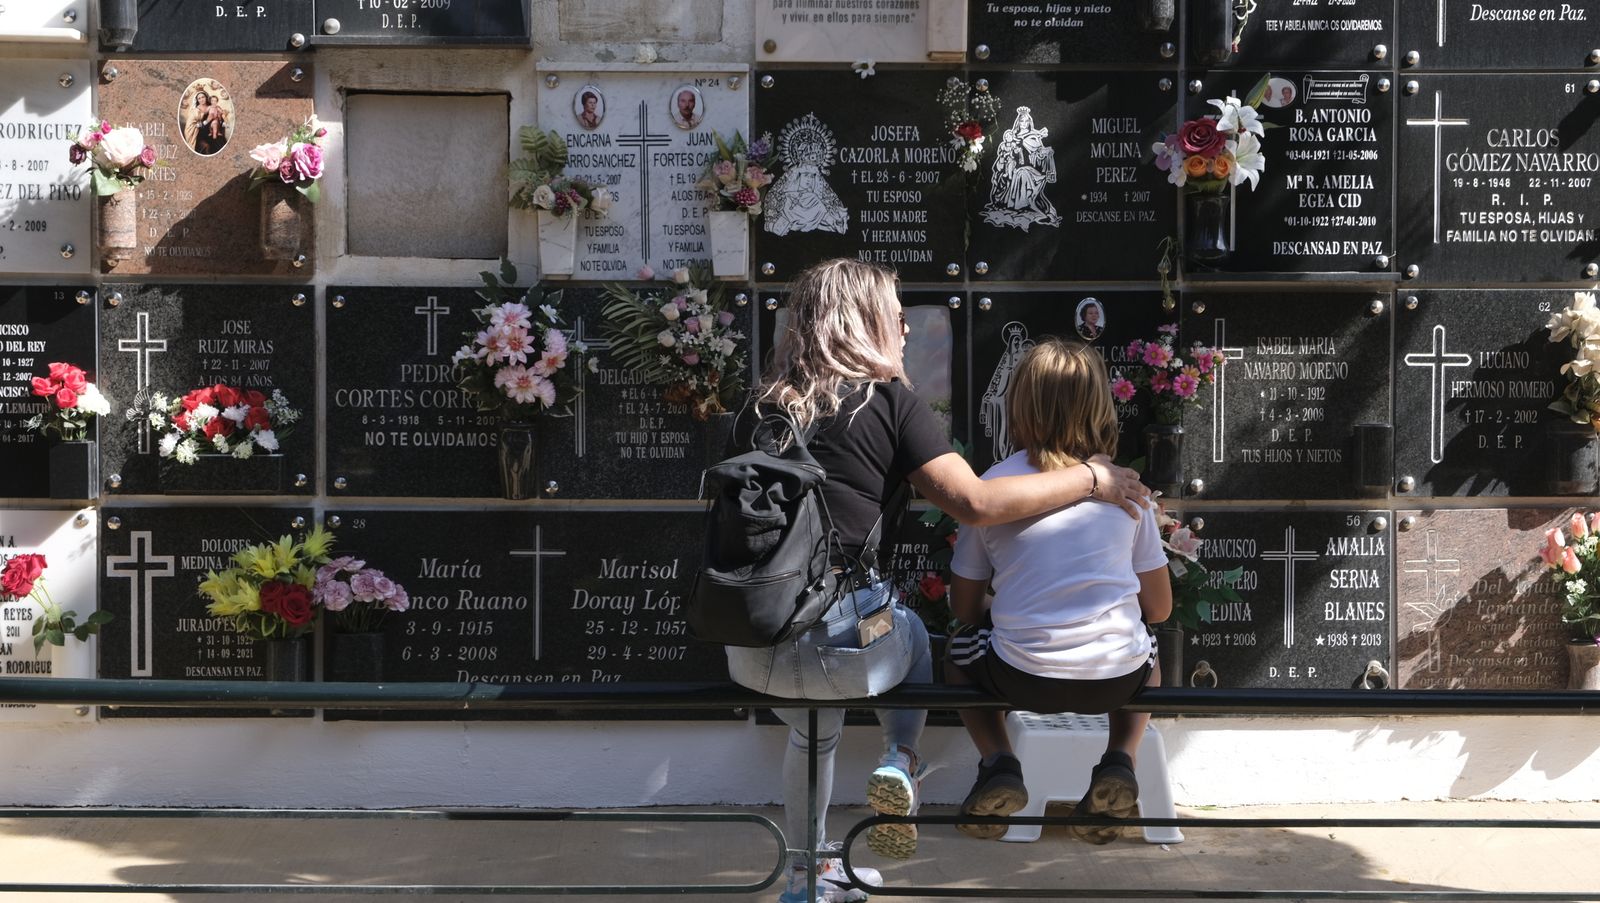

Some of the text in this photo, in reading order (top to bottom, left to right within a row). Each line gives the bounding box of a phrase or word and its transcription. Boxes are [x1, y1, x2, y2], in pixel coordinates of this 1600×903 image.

[216, 6, 267, 18] D. E. P.
[987, 3, 999, 13] Tu
[1003, 5, 1043, 15] esposa,
[1046, 3, 1071, 15] hijas
[1074, 6, 1081, 15] y
[1470, 4, 1588, 21] Descanse en Paz.
[813, 13, 823, 23] en
[827, 11, 848, 23] ellos
[851, 13, 872, 26] para
[1031, 18, 1041, 27] te
[1044, 17, 1084, 27] olvidan
[1284, 20, 1307, 31] ABUELA
[1307, 20, 1329, 31] NUNCA
[1330, 20, 1340, 31] OS
[1340, 20, 1383, 31] OLVIDAREMOS.
[708, 78, 720, 88] 24
[1565, 83, 1575, 93] 61
[1295, 108, 1371, 123] B. ANTONIO
[1092, 117, 1141, 134] MIGUEL
[566, 133, 611, 148] ENCARNA
[686, 132, 713, 146] JUAN
[871, 125, 920, 142] JOSEFA
[1289, 127, 1377, 142] ROSA GARCIA
[1486, 128, 1560, 148] CARLOS
[840, 147, 956, 164] CAZORLA MORENO
[1090, 142, 1142, 159] MOLINA
[592, 153, 636, 168] SANCHEZ
[653, 152, 694, 167] FORTES
[1446, 147, 1600, 172] GÓMEZ NAVARRO
[1096, 166, 1137, 183] PEREZ
[1306, 175, 1319, 190] R.
[1322, 175, 1374, 190] AMELIA
[18, 183, 44, 201] DEL
[49, 183, 82, 201] PINO
[867, 190, 922, 203] TU ESPOSO
[1491, 193, 1553, 206] R. I. P.
[1299, 193, 1362, 208] EGEA CID
[860, 210, 928, 223] HIJOS MADRE
[1076, 211, 1155, 223] DESCANSE EN PAZ
[1460, 212, 1477, 224] TU
[1479, 212, 1536, 226] ESPOSA,
[1538, 212, 1574, 224] HIJAS
[662, 224, 706, 236] TU ESPOSA
[862, 230, 927, 243] Y HERMANOS
[1446, 229, 1598, 243] FAMILIA NO TE OLVIDAN.
[674, 242, 705, 253] FAMILIA
[1273, 241, 1383, 255] DESCANSAD EN PAZ
[858, 249, 933, 262] NO TE OLVIDAN
[580, 260, 627, 271] NO TE OLVIDA
[53, 291, 65, 300] 13
[1539, 302, 1550, 312] 62
[221, 319, 252, 335] JOSE
[6, 340, 46, 352] DEL REY
[198, 340, 274, 355] RUIZ MIRAS
[1256, 337, 1336, 355] ISABEL MARIA
[1479, 351, 1530, 369] LUCIANO
[401, 364, 464, 383] PEDRO
[1243, 362, 1349, 380] NAVARRO MORENO
[209, 374, 228, 386] LOS
[230, 374, 242, 386] 84
[1451, 380, 1555, 398] HERMOSO ROMERO
[335, 388, 415, 409] CORTES
[364, 431, 498, 447] NO TE OLVIDAMOS
[615, 431, 627, 444] TU
[630, 431, 648, 445] HIJO
[661, 431, 690, 444] ESPOSA
[620, 446, 685, 459] NO TE OLVIDAN
[1242, 449, 1342, 463] TUS HIJOS Y NIETOS
[352, 518, 367, 529] 28
[1347, 515, 1361, 527] 56
[1198, 538, 1256, 559] FRANCISCO
[1325, 536, 1385, 556] AMALIA
[180, 555, 223, 570] MEDINA
[418, 558, 482, 579] María
[598, 558, 679, 579] Marisol
[1330, 569, 1380, 590] SERNA
[456, 589, 528, 610] Ruano
[571, 589, 635, 615] Doray
[4, 607, 33, 621] REYES
[1325, 602, 1385, 621] BLANES
[176, 618, 220, 633] JURADO
[1202, 633, 1221, 646] 1923
[1233, 631, 1256, 646] 2008
[1327, 632, 1348, 647] 1938
[1360, 633, 1382, 647] 2013
[6, 660, 52, 674] RODRIGUE
[185, 665, 264, 678] DESCANSAN EN PAZ.
[1269, 666, 1317, 678] D. E. P.
